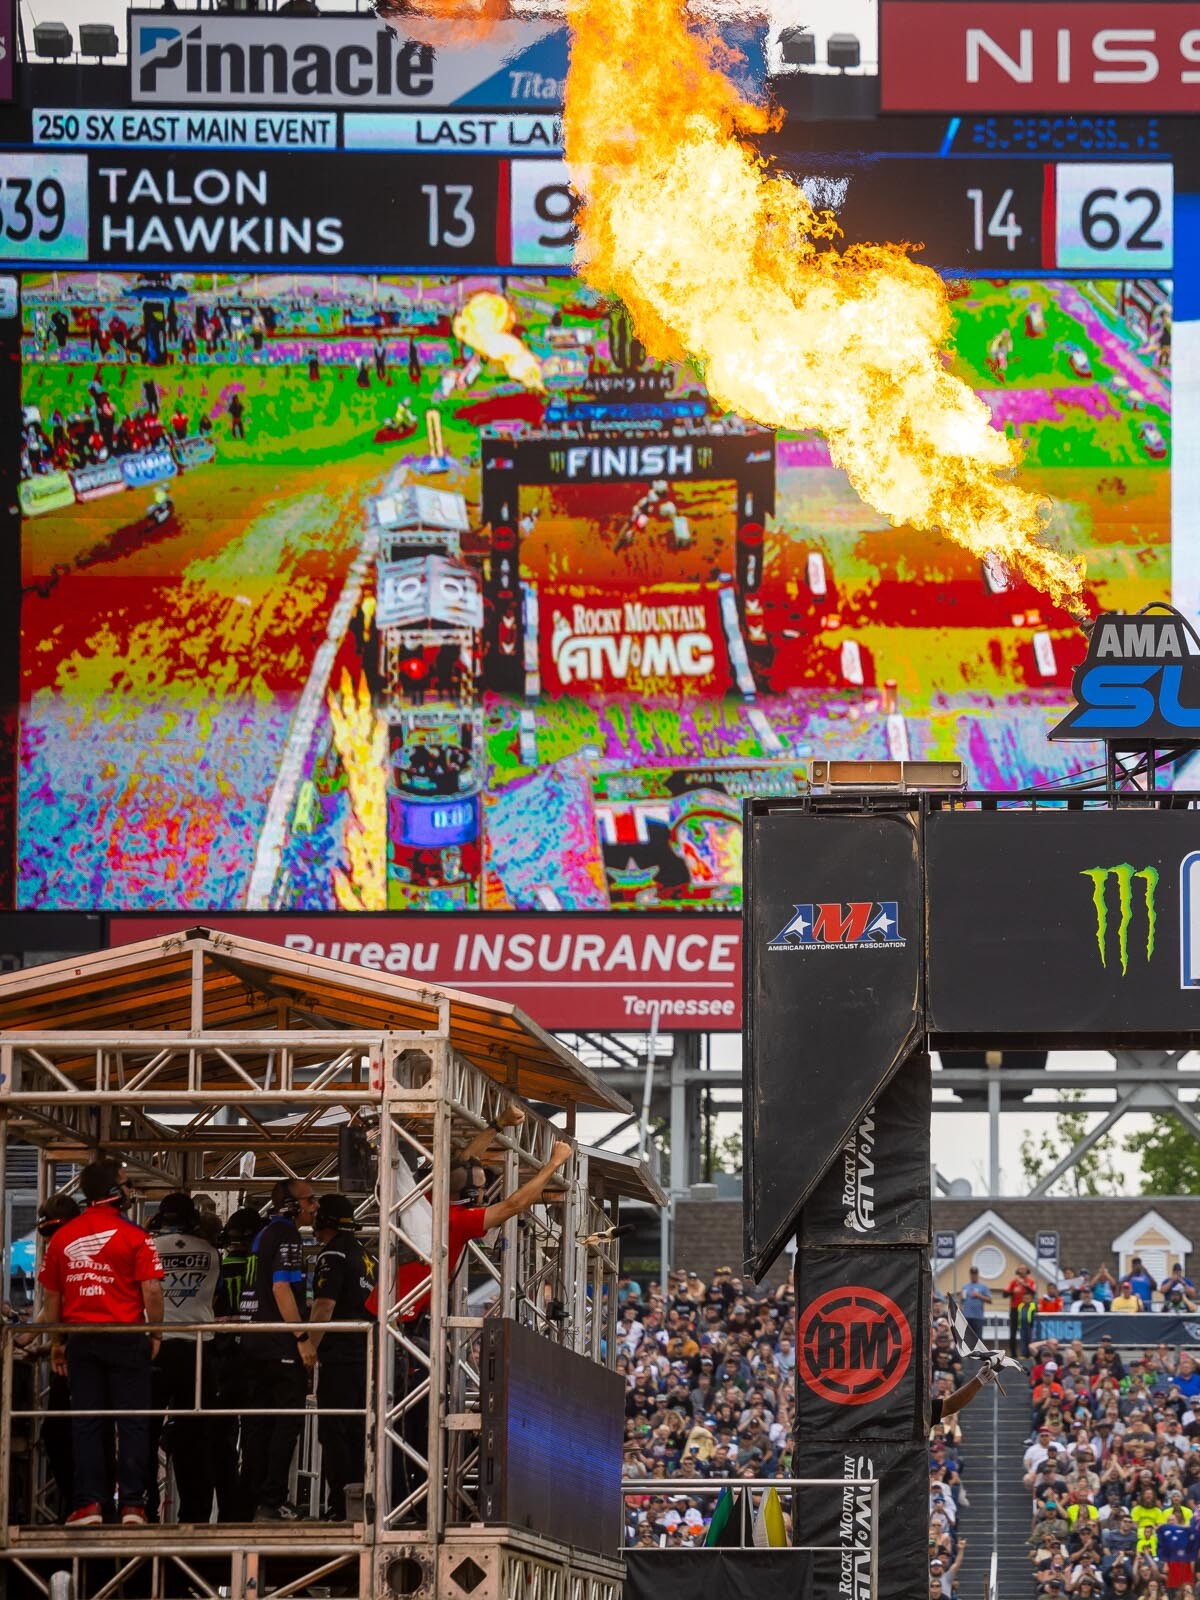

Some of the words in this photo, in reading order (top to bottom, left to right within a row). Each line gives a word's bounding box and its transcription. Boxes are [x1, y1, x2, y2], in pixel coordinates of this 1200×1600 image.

[140, 23, 436, 97] Pinnacle
[39, 115, 78, 142] 250
[87, 116, 115, 142] SX
[123, 116, 180, 143] EAST
[187, 117, 246, 144] MAIN
[254, 119, 331, 145] EVENT
[416, 120, 497, 144] LAST
[98, 168, 267, 206] TALON
[0, 178, 66, 242] 39
[421, 185, 476, 248] 13
[967, 188, 1022, 251] 14
[1080, 188, 1163, 252] 62
[102, 217, 344, 254] HAWKINS
[567, 444, 694, 478] FINISH
[573, 604, 621, 634] ROCKY
[625, 602, 706, 633] MOUNTAIN
[1097, 623, 1182, 658] AMA
[766, 901, 907, 944] AMA
[454, 933, 740, 973] INSURANCE
[805, 943, 858, 951] MOTORCYCLIST
[859, 941, 906, 949] ASSOCIATION
[622, 995, 735, 1017] Tennessee
[842, 1155, 856, 1208] ROCKY
[818, 1321, 892, 1370] RM
